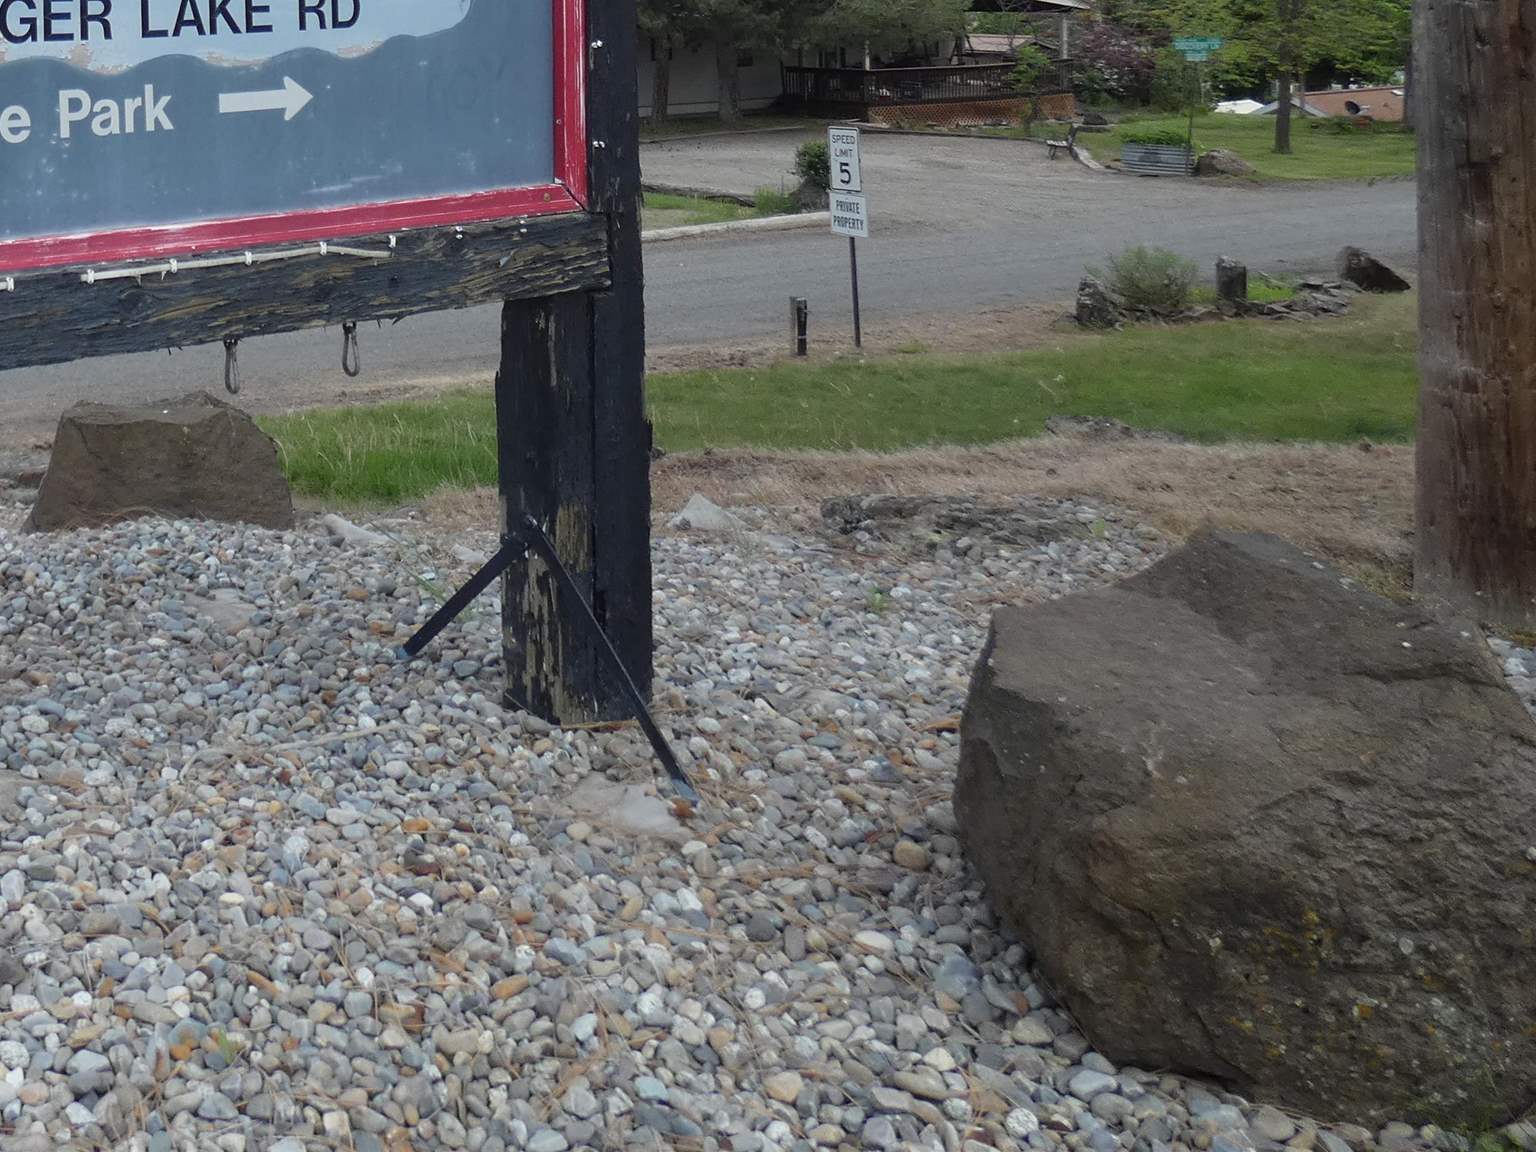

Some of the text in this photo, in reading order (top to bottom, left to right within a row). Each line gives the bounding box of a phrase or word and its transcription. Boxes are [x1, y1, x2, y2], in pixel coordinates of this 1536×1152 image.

[58, 83, 175, 139] Park
[831, 134, 856, 145] SPEED
[834, 148, 853, 158] LIMIT
[839, 161, 852, 185] 5
[835, 199, 860, 215] PRIVATE
[833, 215, 864, 231] PROPERTY
